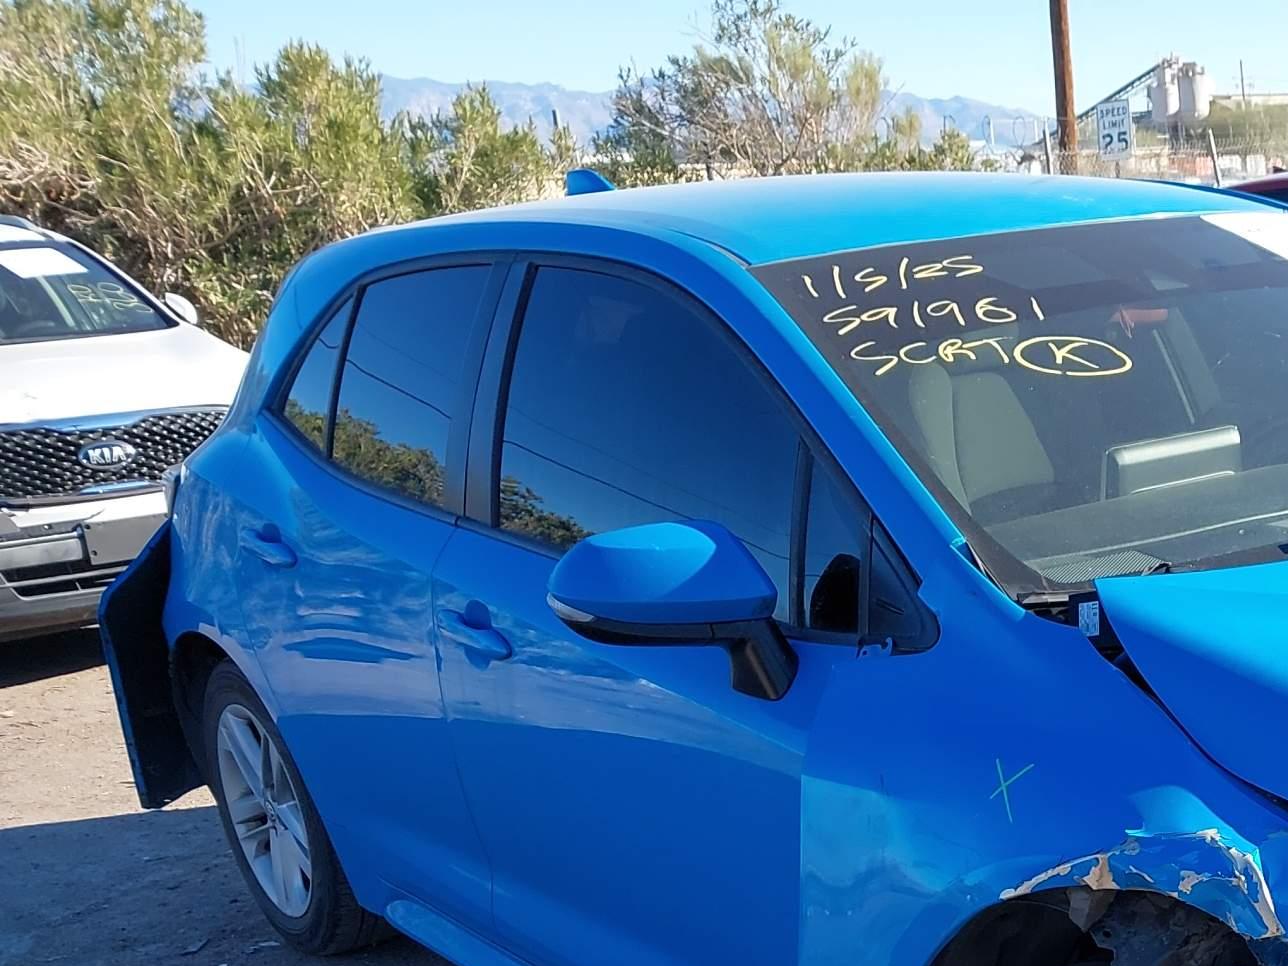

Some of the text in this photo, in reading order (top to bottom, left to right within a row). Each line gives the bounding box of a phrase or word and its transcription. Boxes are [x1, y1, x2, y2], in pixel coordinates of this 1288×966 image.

[1100, 106, 1128, 118] SPEED
[1102, 118, 1126, 131] LIMIT
[1102, 131, 1129, 153] 25
[87, 445, 127, 464] KIA
